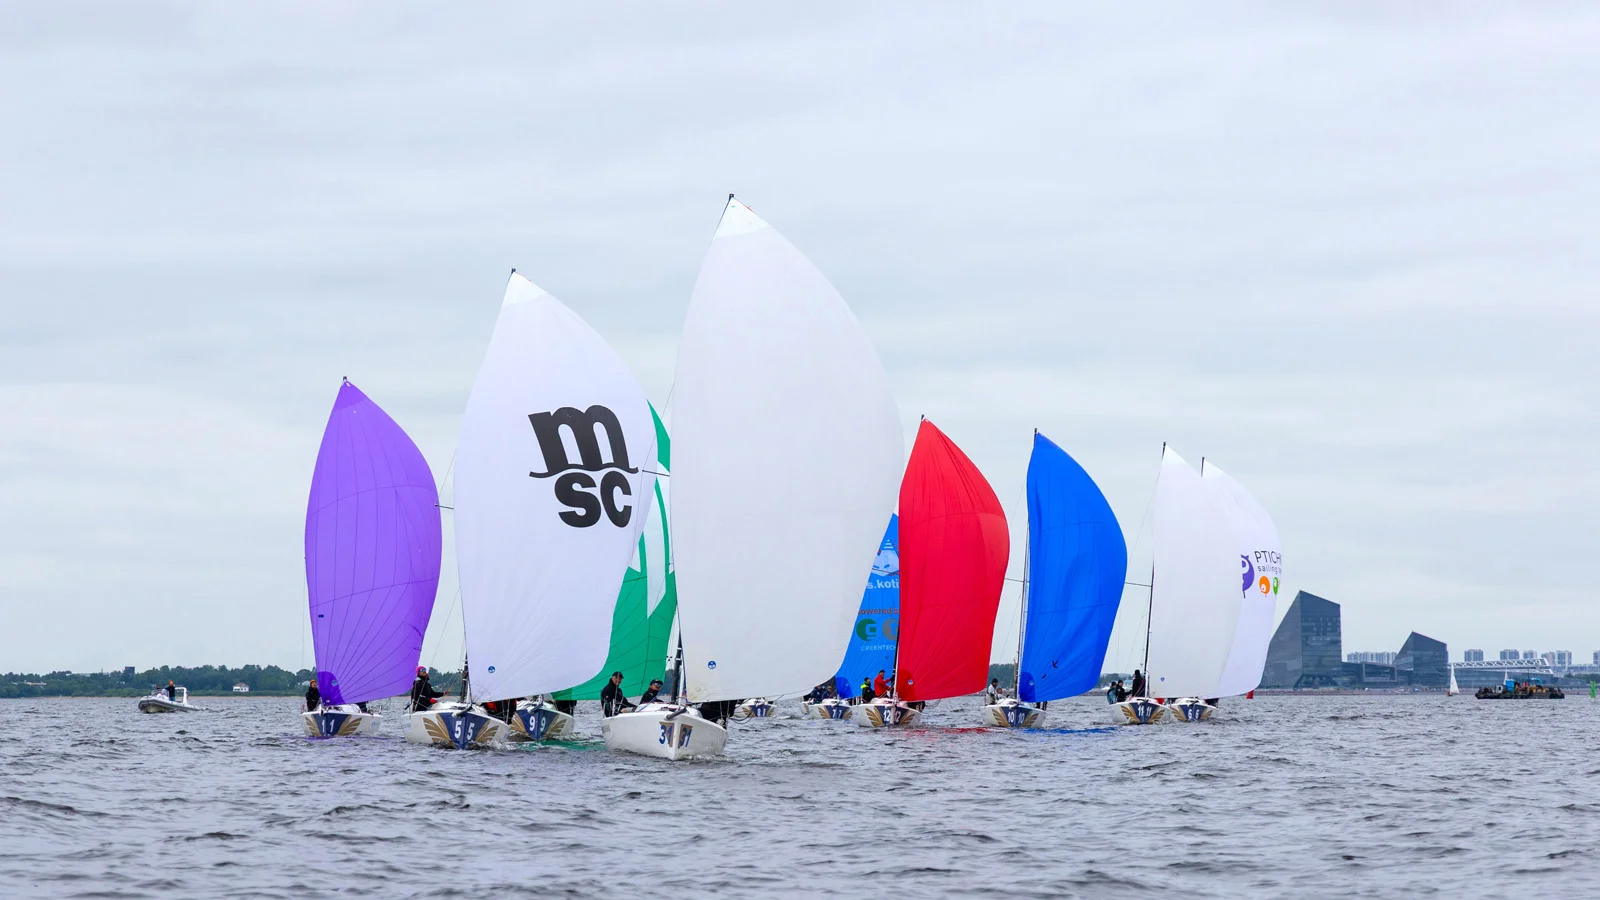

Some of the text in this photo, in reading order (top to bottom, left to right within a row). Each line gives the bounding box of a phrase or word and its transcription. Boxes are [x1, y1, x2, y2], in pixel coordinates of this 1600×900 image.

[454, 720, 462, 739] 5
[466, 722, 475, 740] 5
[529, 715, 536, 731] 9
[540, 716, 547, 732] 9
[659, 725, 673, 745] 31
